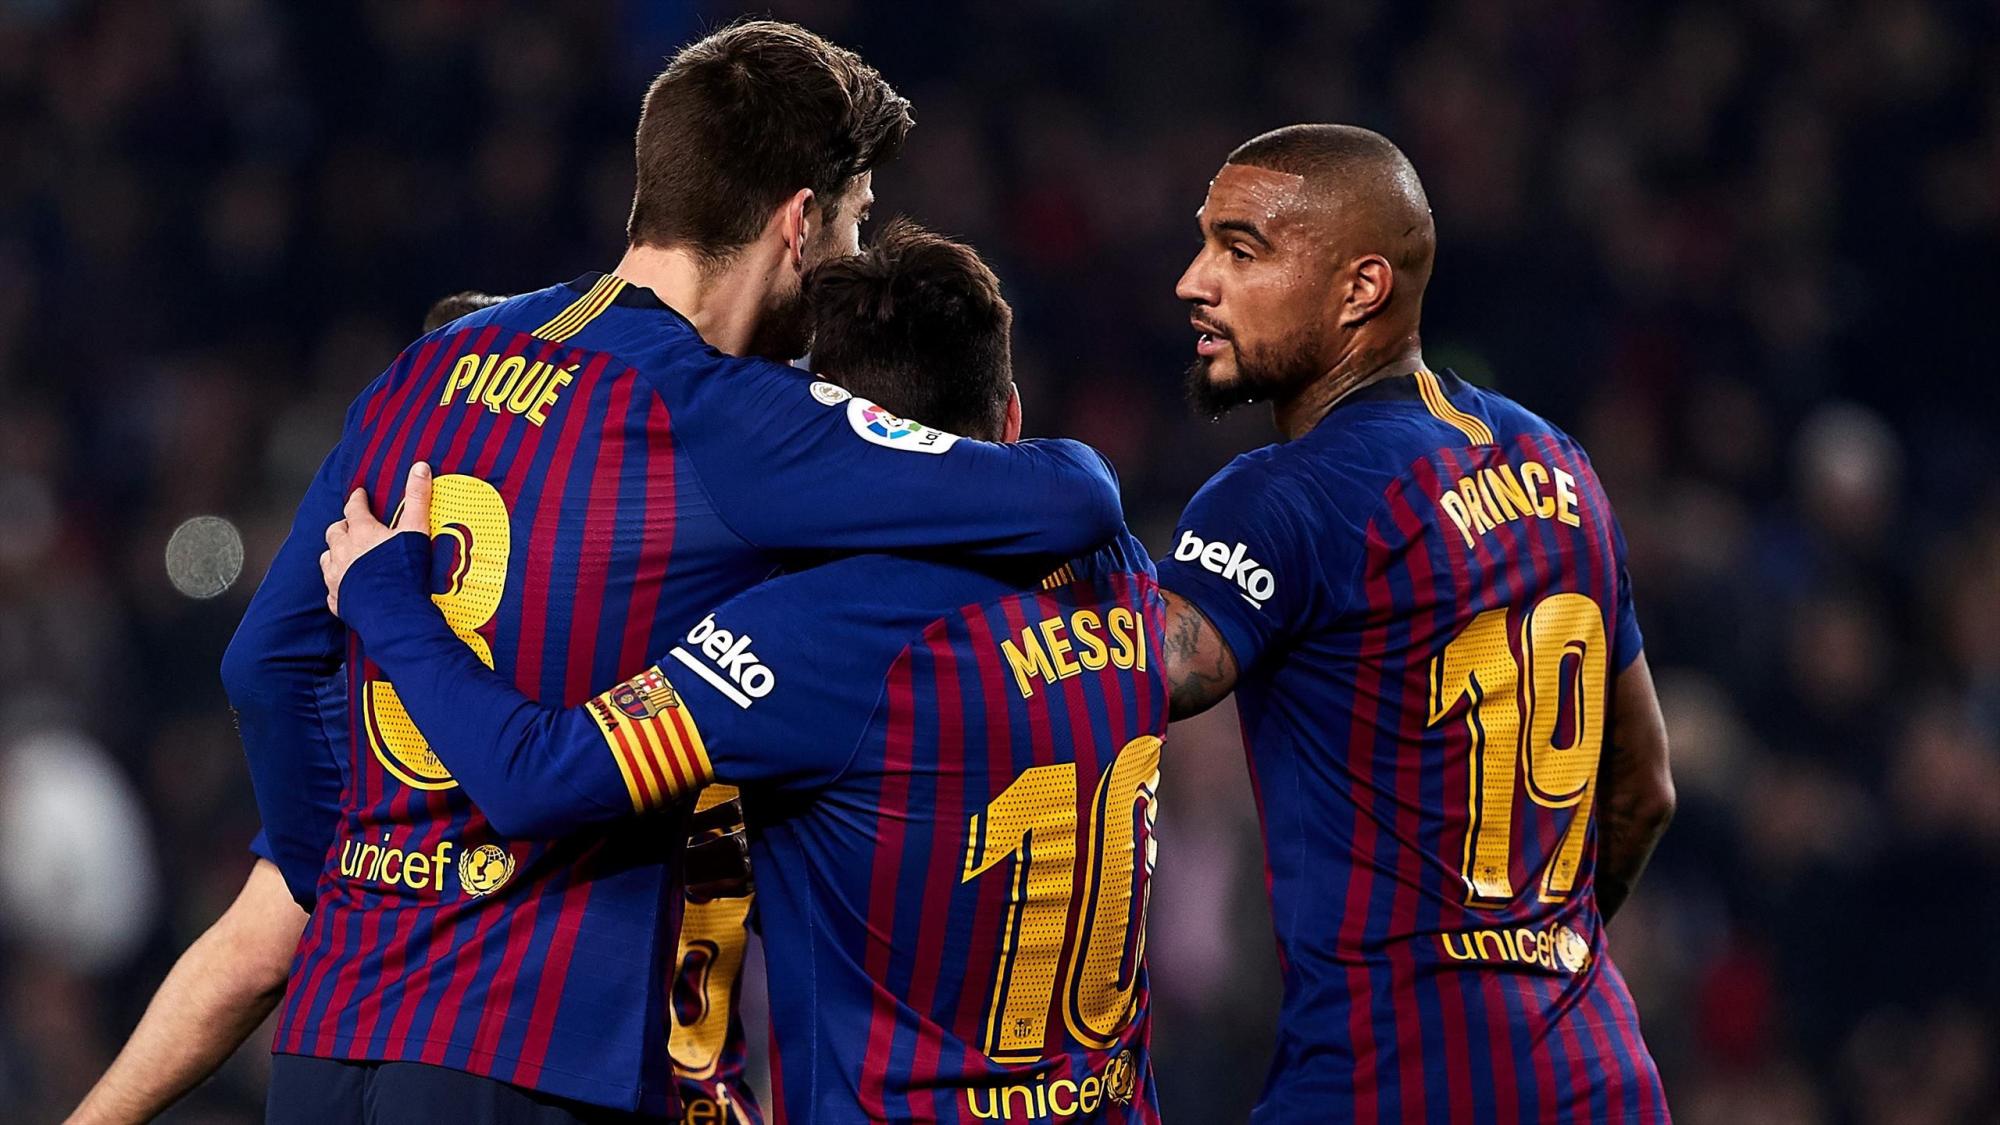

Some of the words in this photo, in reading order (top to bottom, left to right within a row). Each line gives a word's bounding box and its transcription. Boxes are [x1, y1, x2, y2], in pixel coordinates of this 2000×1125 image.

[440, 353, 581, 428] PIQUÉ
[1440, 461, 1580, 550] PRINCE
[1174, 530, 1275, 601] beko
[687, 612, 776, 698] beko
[1000, 607, 1147, 699] MESSI
[1428, 592, 1607, 908] 19
[340, 832, 453, 891] unicef
[961, 735, 1162, 1064] 10
[1441, 921, 1559, 970] unicef
[966, 1058, 1116, 1120] unicef
